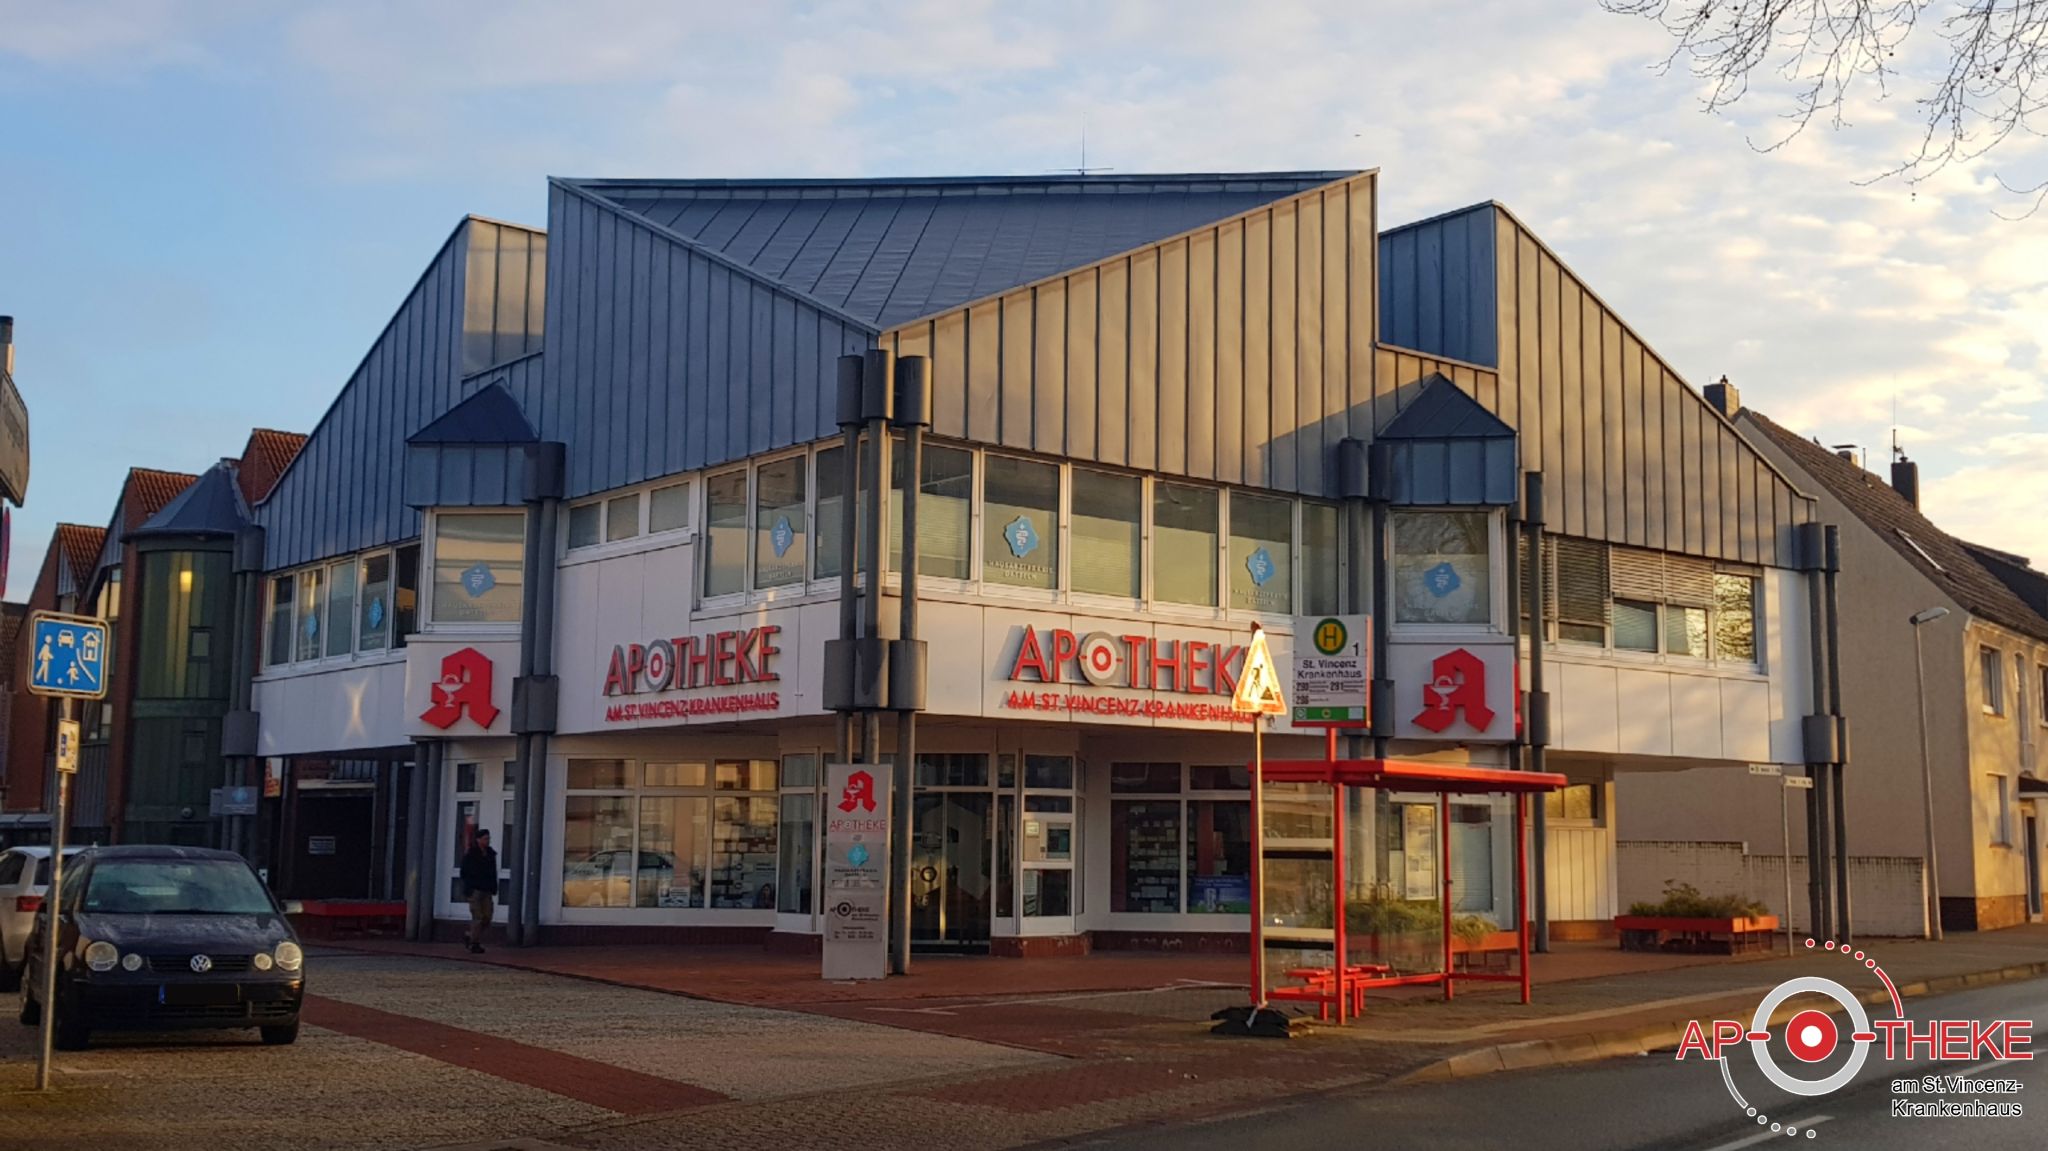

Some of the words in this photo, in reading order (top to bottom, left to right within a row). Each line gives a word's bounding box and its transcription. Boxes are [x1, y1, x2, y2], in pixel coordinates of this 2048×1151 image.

[1352, 641, 1359, 657] 1
[603, 625, 782, 697] APOTHEKE
[1318, 659, 1357, 669] Vincenz
[1297, 670, 1362, 680] Krankenhaus
[1007, 690, 1036, 710] AM
[829, 819, 886, 831] APOTHEKE
